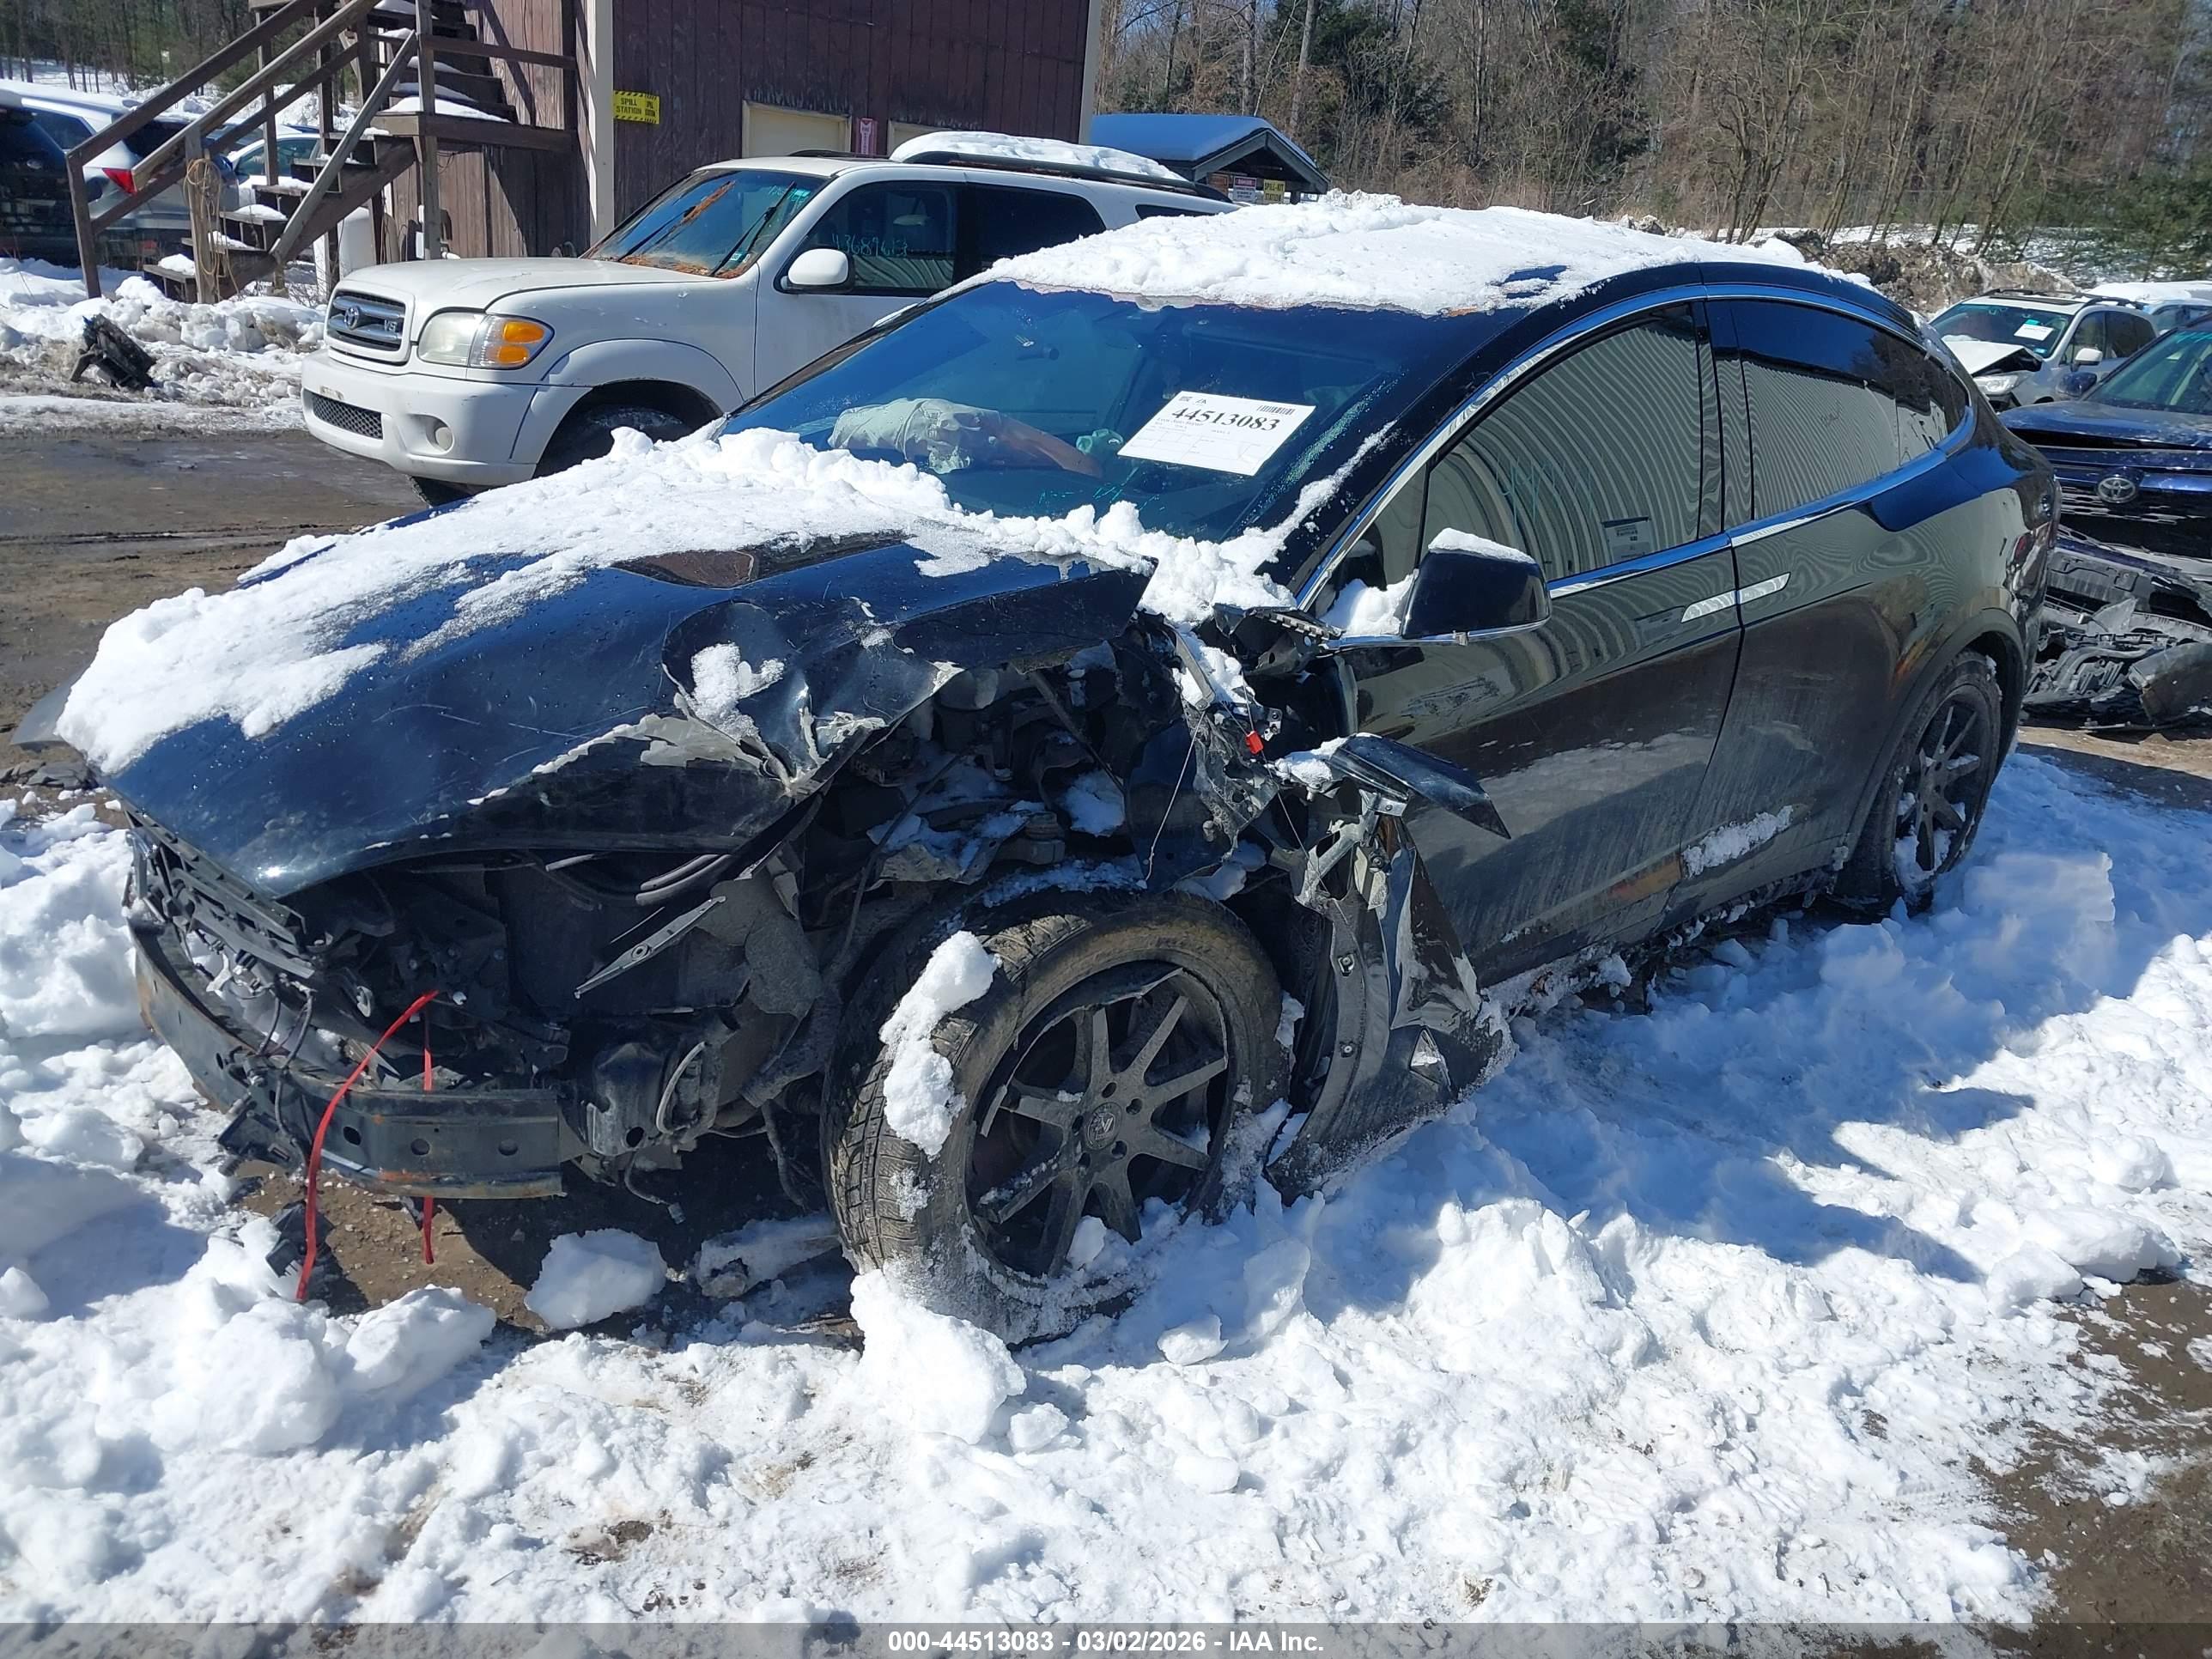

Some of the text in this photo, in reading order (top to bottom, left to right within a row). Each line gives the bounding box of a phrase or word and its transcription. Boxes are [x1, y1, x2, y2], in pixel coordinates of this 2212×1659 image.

[621, 97, 637, 106] SPILL
[616, 106, 641, 115] STATION
[384, 319, 398, 333] V8
[1171, 407, 1280, 430] 44513083
